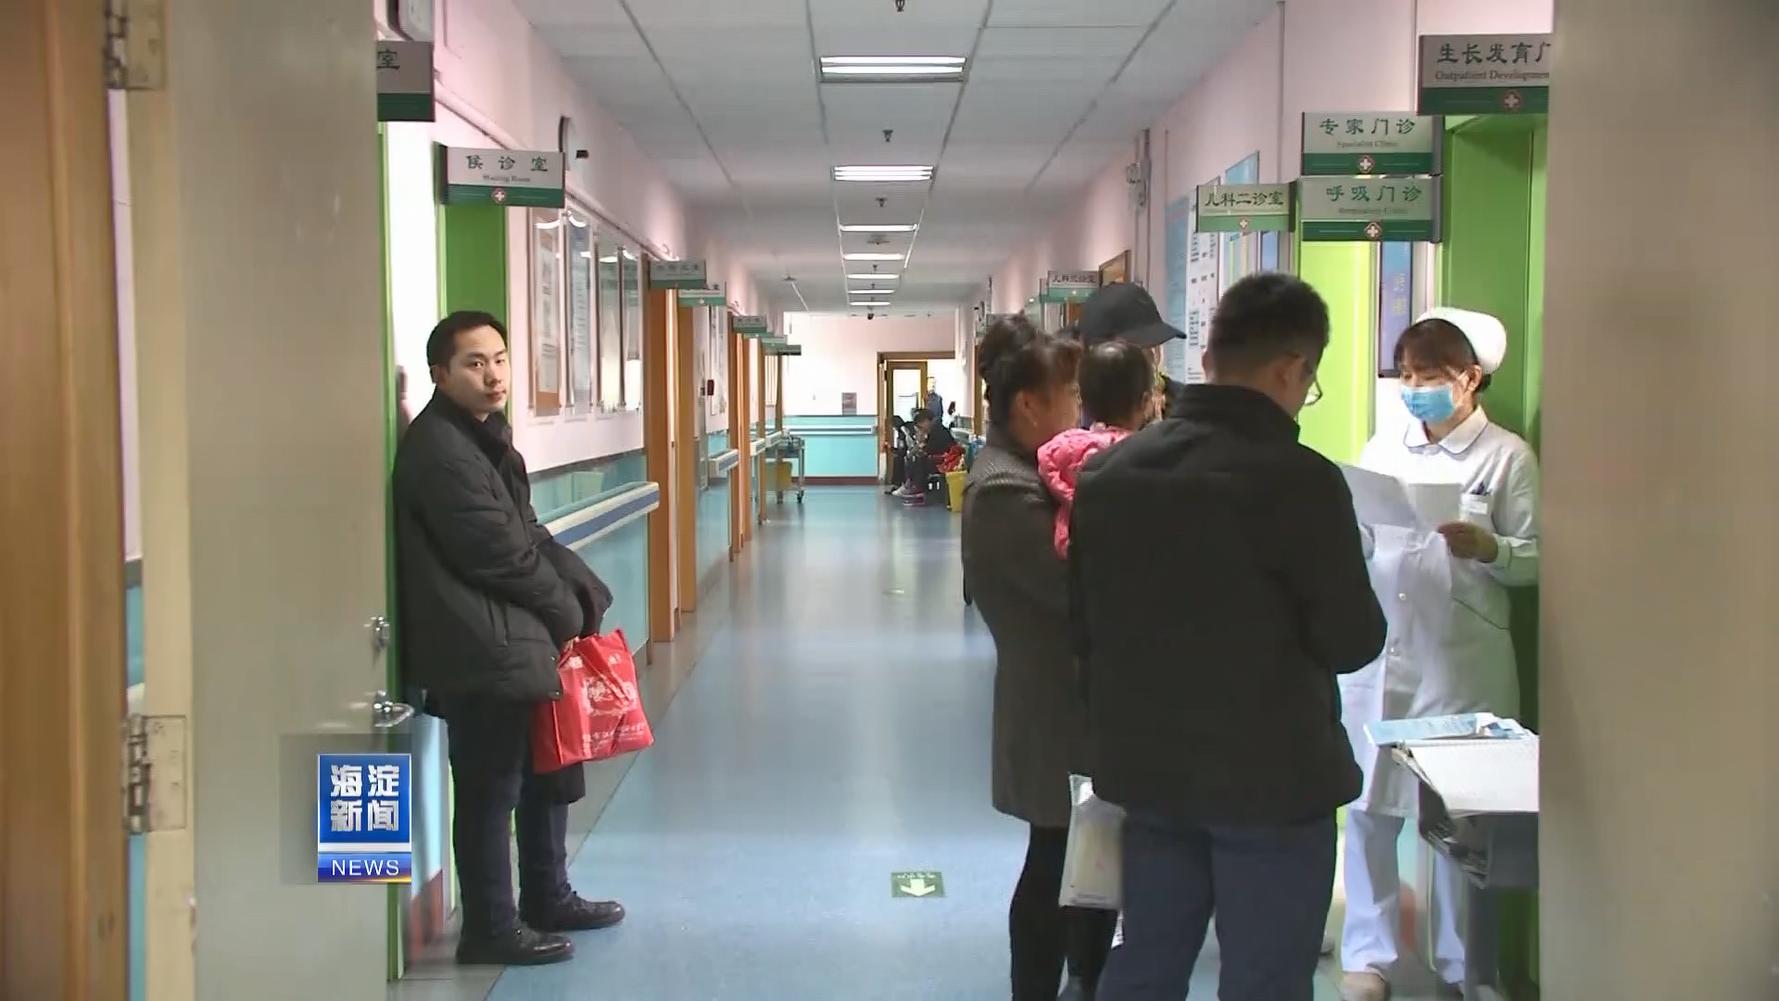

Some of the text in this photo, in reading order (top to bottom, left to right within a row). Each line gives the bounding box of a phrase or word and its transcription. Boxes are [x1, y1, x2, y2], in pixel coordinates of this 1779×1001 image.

[376, 48, 400, 70] 室
[1435, 70, 1487, 82] Outpatient
[1319, 118, 1416, 136] 专家门诊
[1204, 190, 1284, 206] 儿科二诊室
[1326, 185, 1422, 202] 呼吸门诊
